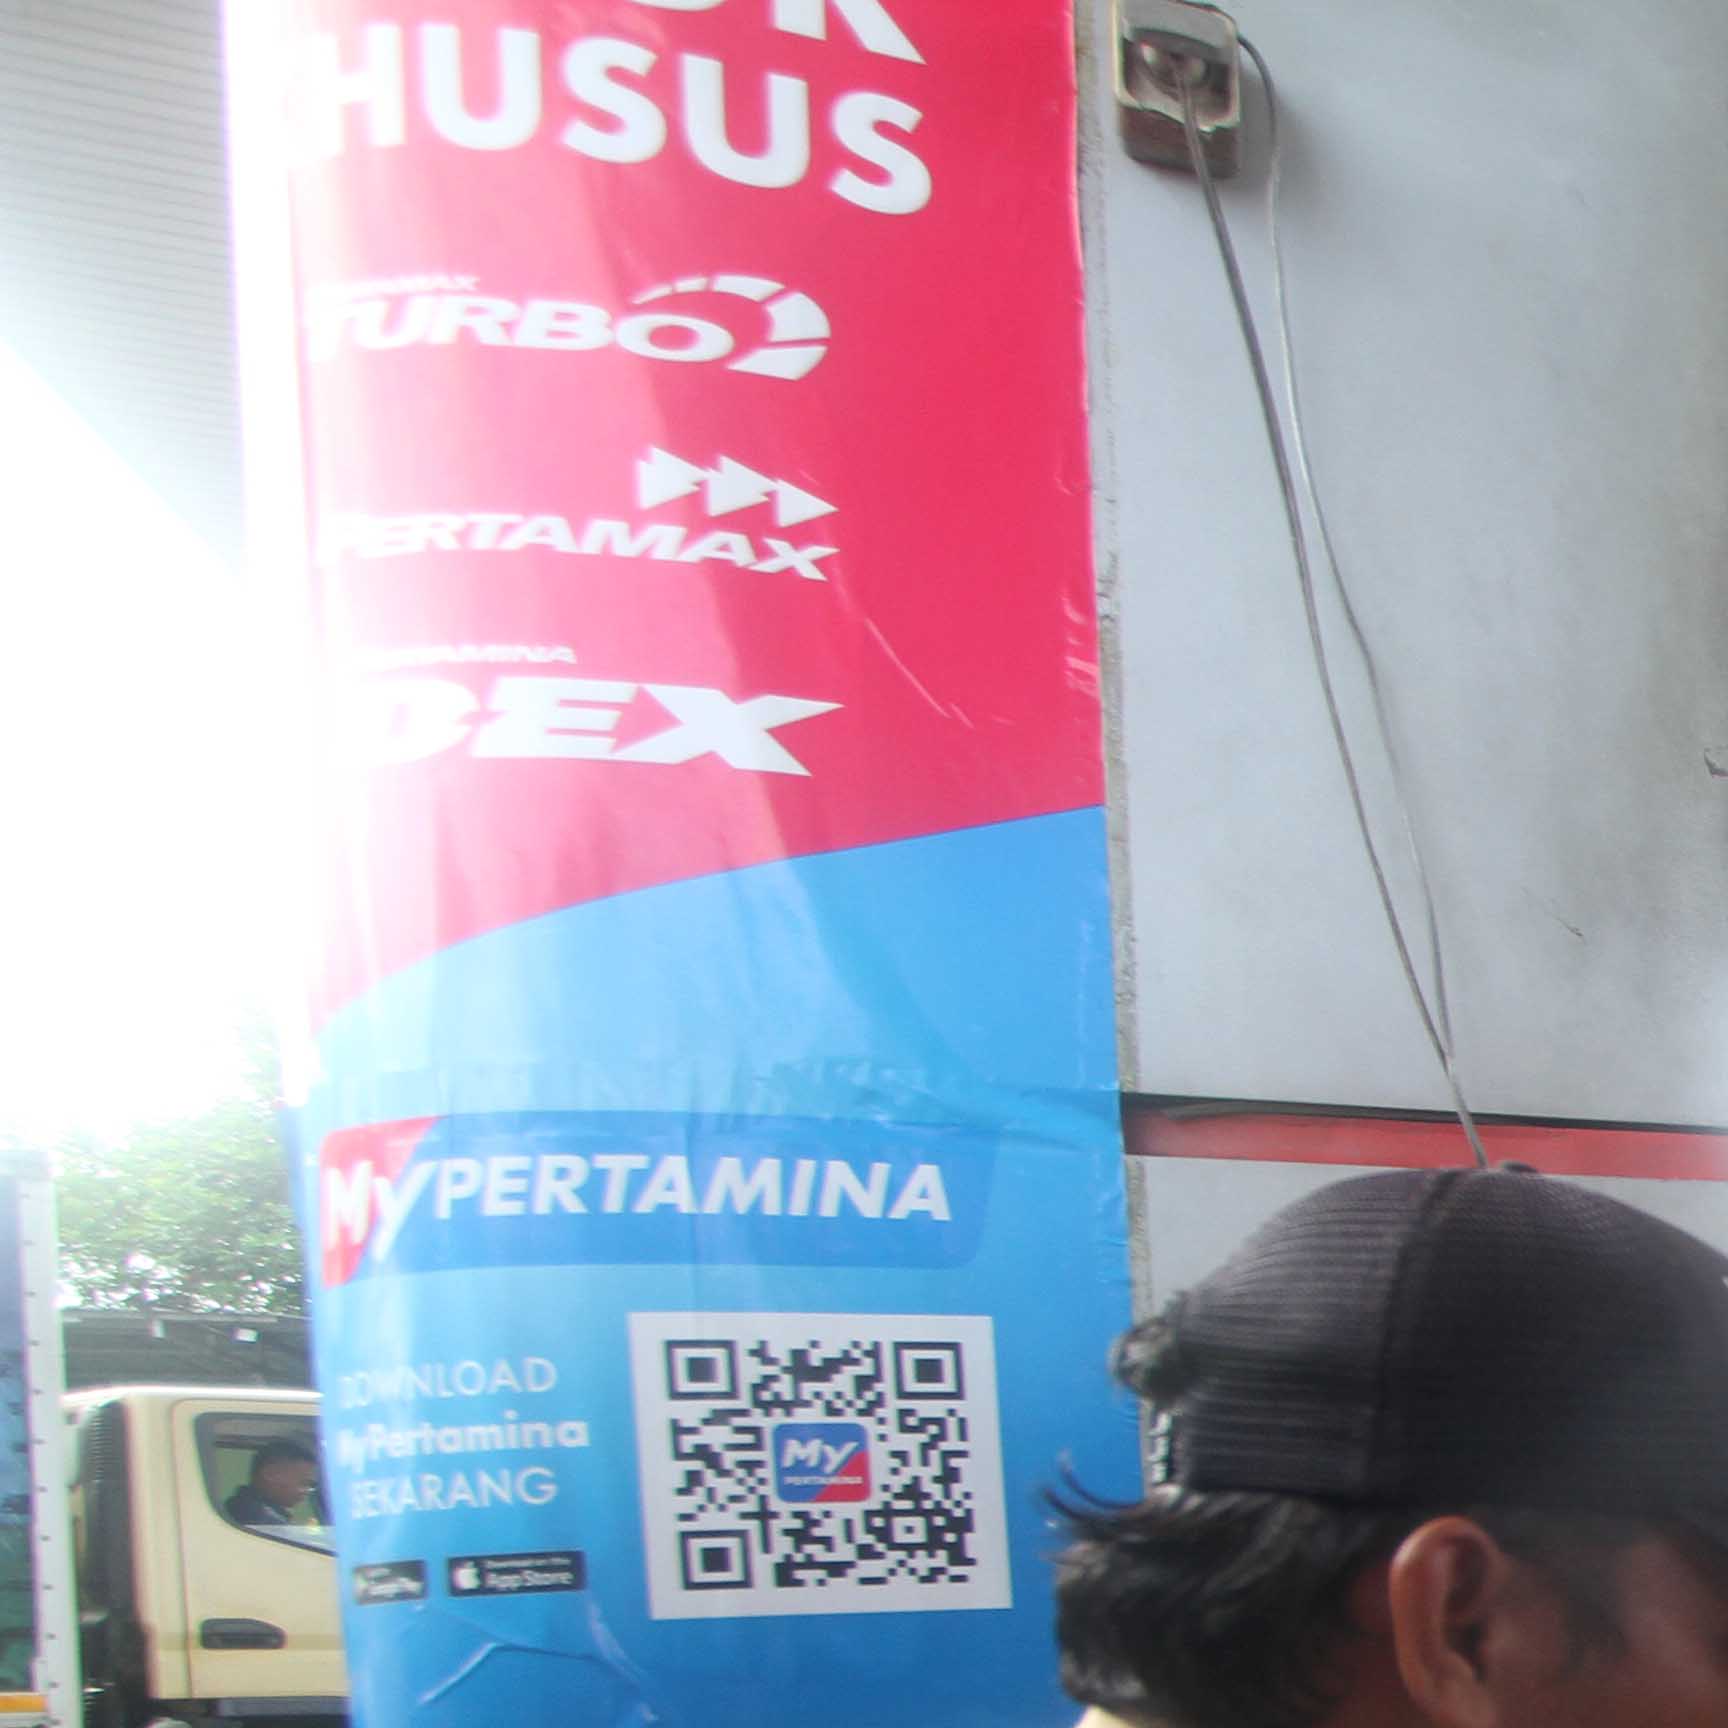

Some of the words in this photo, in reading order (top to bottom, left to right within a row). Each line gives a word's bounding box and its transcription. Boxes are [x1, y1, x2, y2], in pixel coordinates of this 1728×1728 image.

[306, 295, 735, 363] TURBO
[335, 674, 845, 777] DEX
[339, 1355, 558, 1409] DOWNLOAD
[782, 1438, 860, 1474] My
[350, 1466, 559, 1520] SEKARANG
